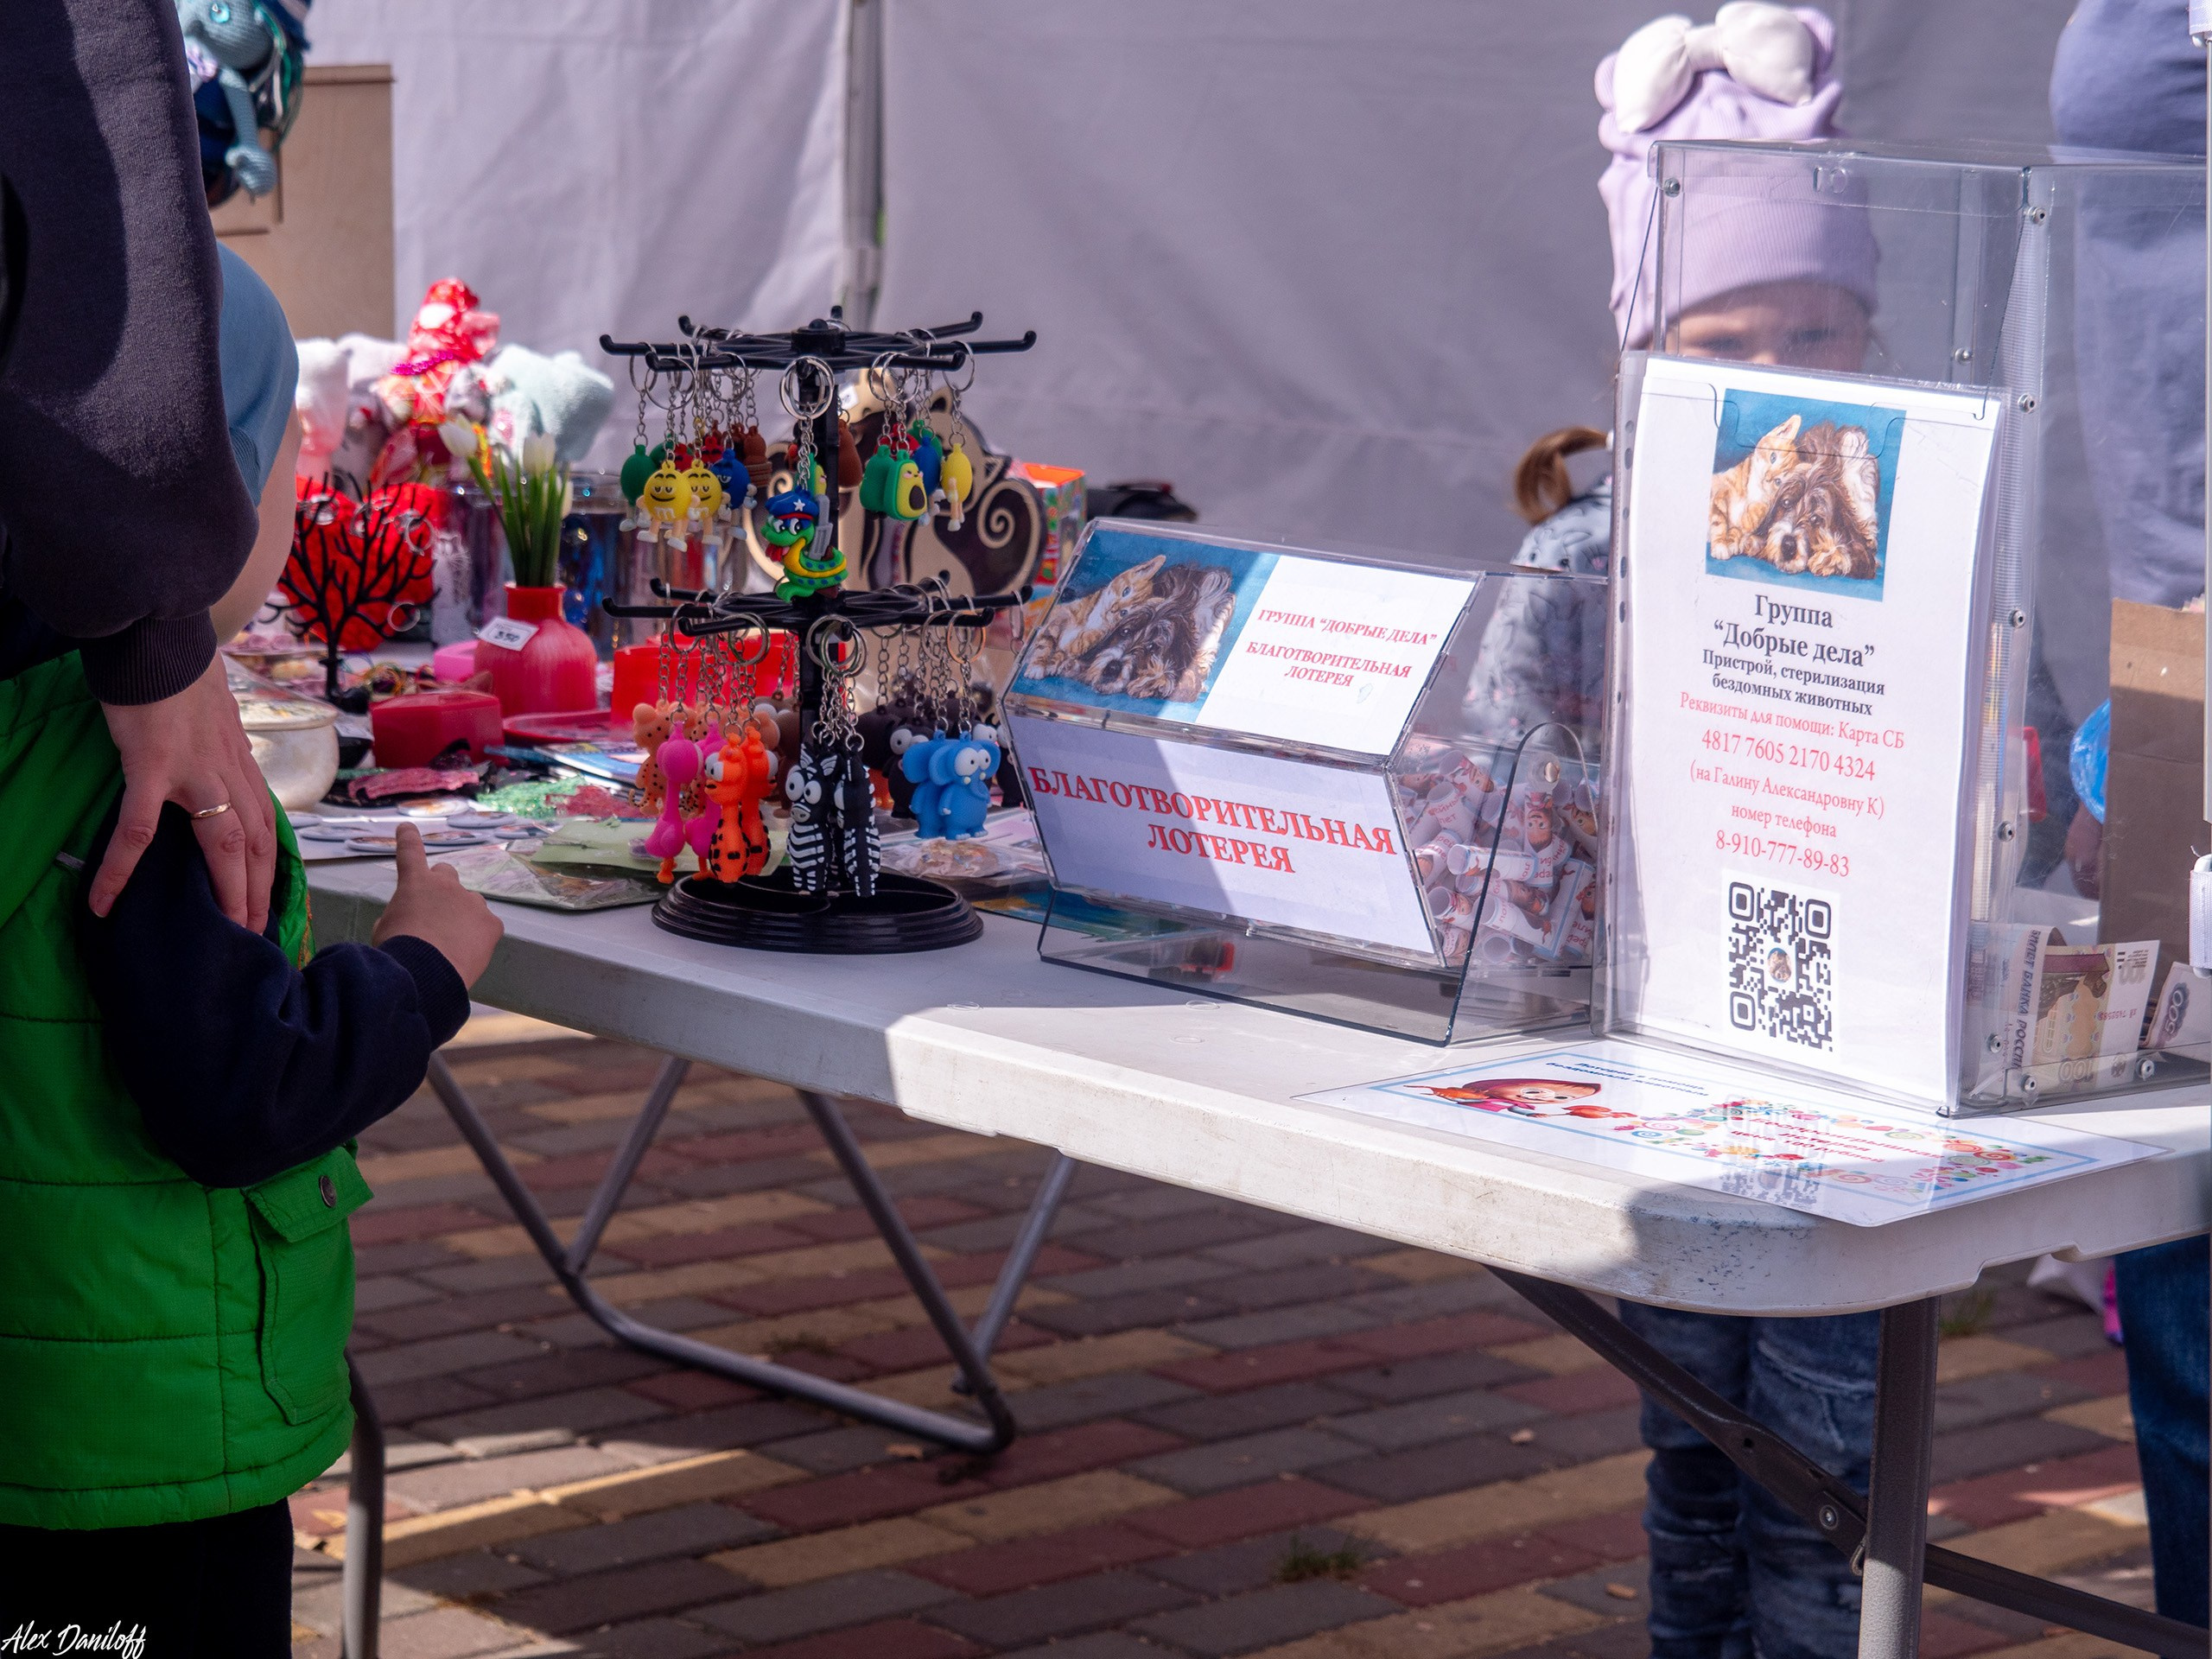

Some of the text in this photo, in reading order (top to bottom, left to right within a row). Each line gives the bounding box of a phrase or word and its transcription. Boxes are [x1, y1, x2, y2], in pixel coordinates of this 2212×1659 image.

[1257, 609, 1315, 628] ГРУППА
[1755, 594, 1833, 628] Группа
[1246, 641, 1413, 678] БЛАГОТВОРИТЕЛЬНАЯ
[1714, 620, 1875, 667] “Добрые дела”
[1284, 665, 1354, 687] ЛОТЕРЕЯ
[1702, 649, 1885, 696] Пристрой, стерилизация
[1712, 673, 1872, 715] бездомных животных
[1680, 692, 1904, 749] Реквизиты для помощи: Карта СБ
[1701, 729, 1875, 781] 4817 7605 2170 4324
[1027, 766, 1398, 855] БЛАГОТВОРИТЕЛЬНАЯ
[1690, 760, 1885, 820] (на Галину Александровну К)
[1732, 804, 1837, 838] номер телефона
[1147, 823, 1297, 874] ЛОТЕРЕЯ
[1716, 830, 1849, 877] 8-910-777-89-83
[2017, 969, 2033, 1017] БАНКА
[2164, 988, 2186, 1035] 500
